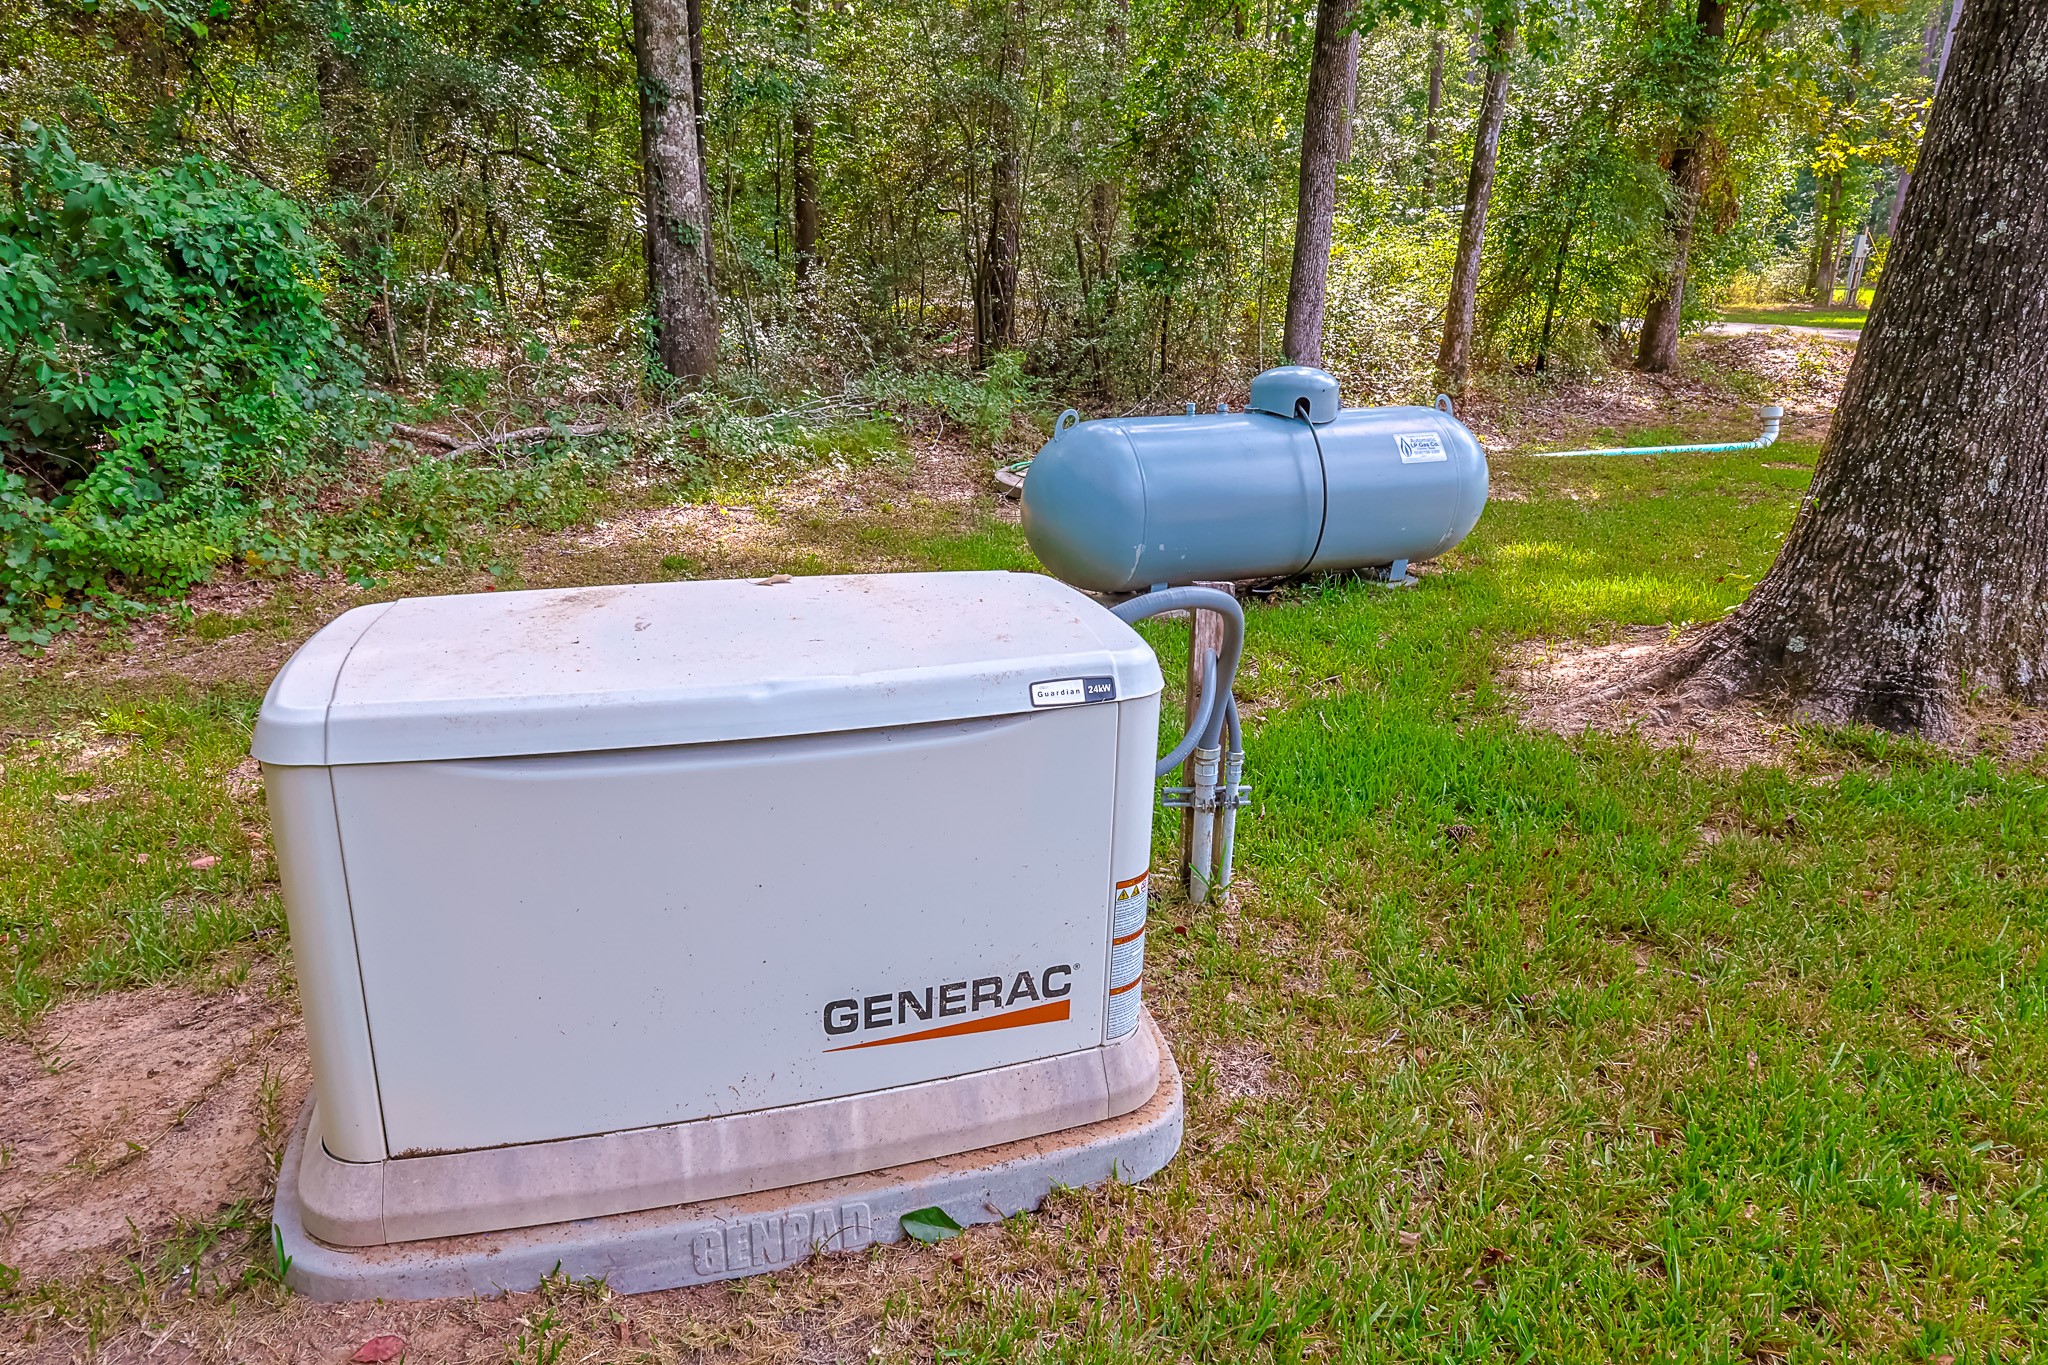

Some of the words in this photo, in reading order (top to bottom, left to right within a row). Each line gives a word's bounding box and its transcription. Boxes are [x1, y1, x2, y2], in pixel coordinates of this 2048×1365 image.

[1037, 689, 1081, 698] Guardian
[1088, 684, 1111, 694] 24kW
[823, 964, 1072, 1035] GENERAC
[693, 1201, 872, 1276] GENPAD
